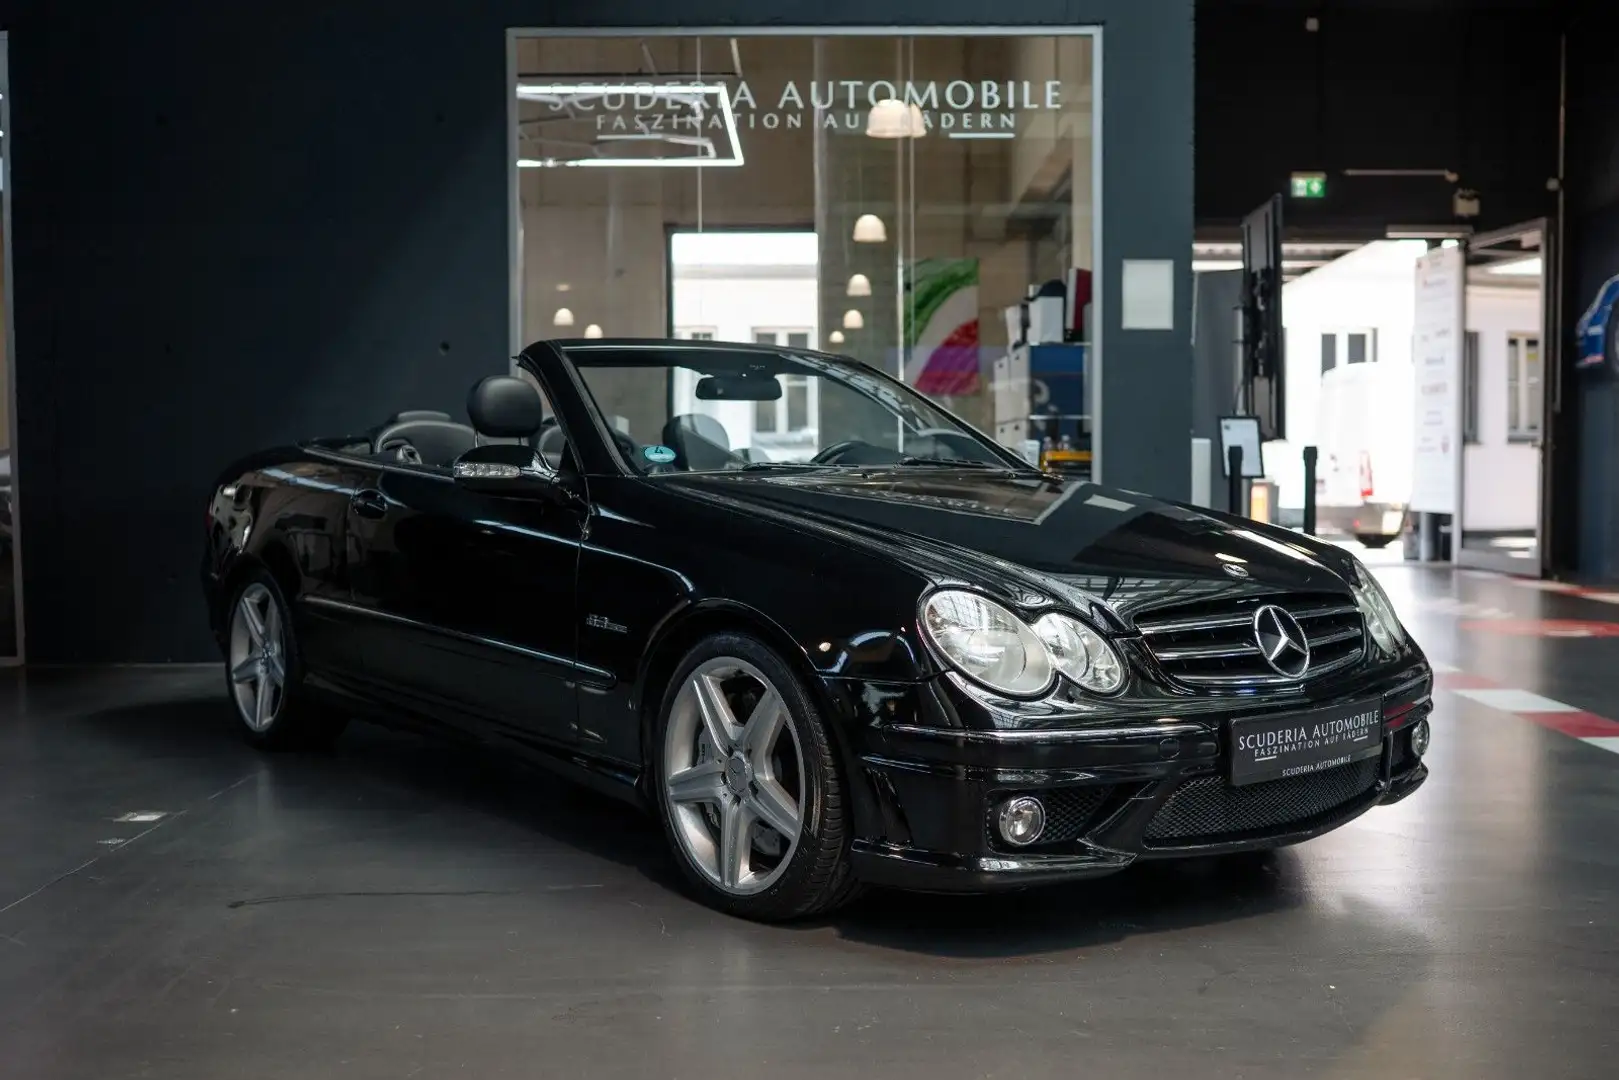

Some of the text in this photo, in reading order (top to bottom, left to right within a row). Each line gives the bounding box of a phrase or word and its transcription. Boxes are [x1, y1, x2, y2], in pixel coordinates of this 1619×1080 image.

[549, 80, 1062, 110] SCUDERIA AUTOMOBILE
[596, 113, 803, 130] FASZINATION
[823, 113, 860, 129] AU
[1238, 710, 1379, 751] SCUDERIA AUTOMOBILE
[1254, 740, 1320, 757] FASZINATION
[1325, 734, 1339, 745] AUF
[1282, 755, 1351, 777] SCUDERIA AUTOMOBILE
